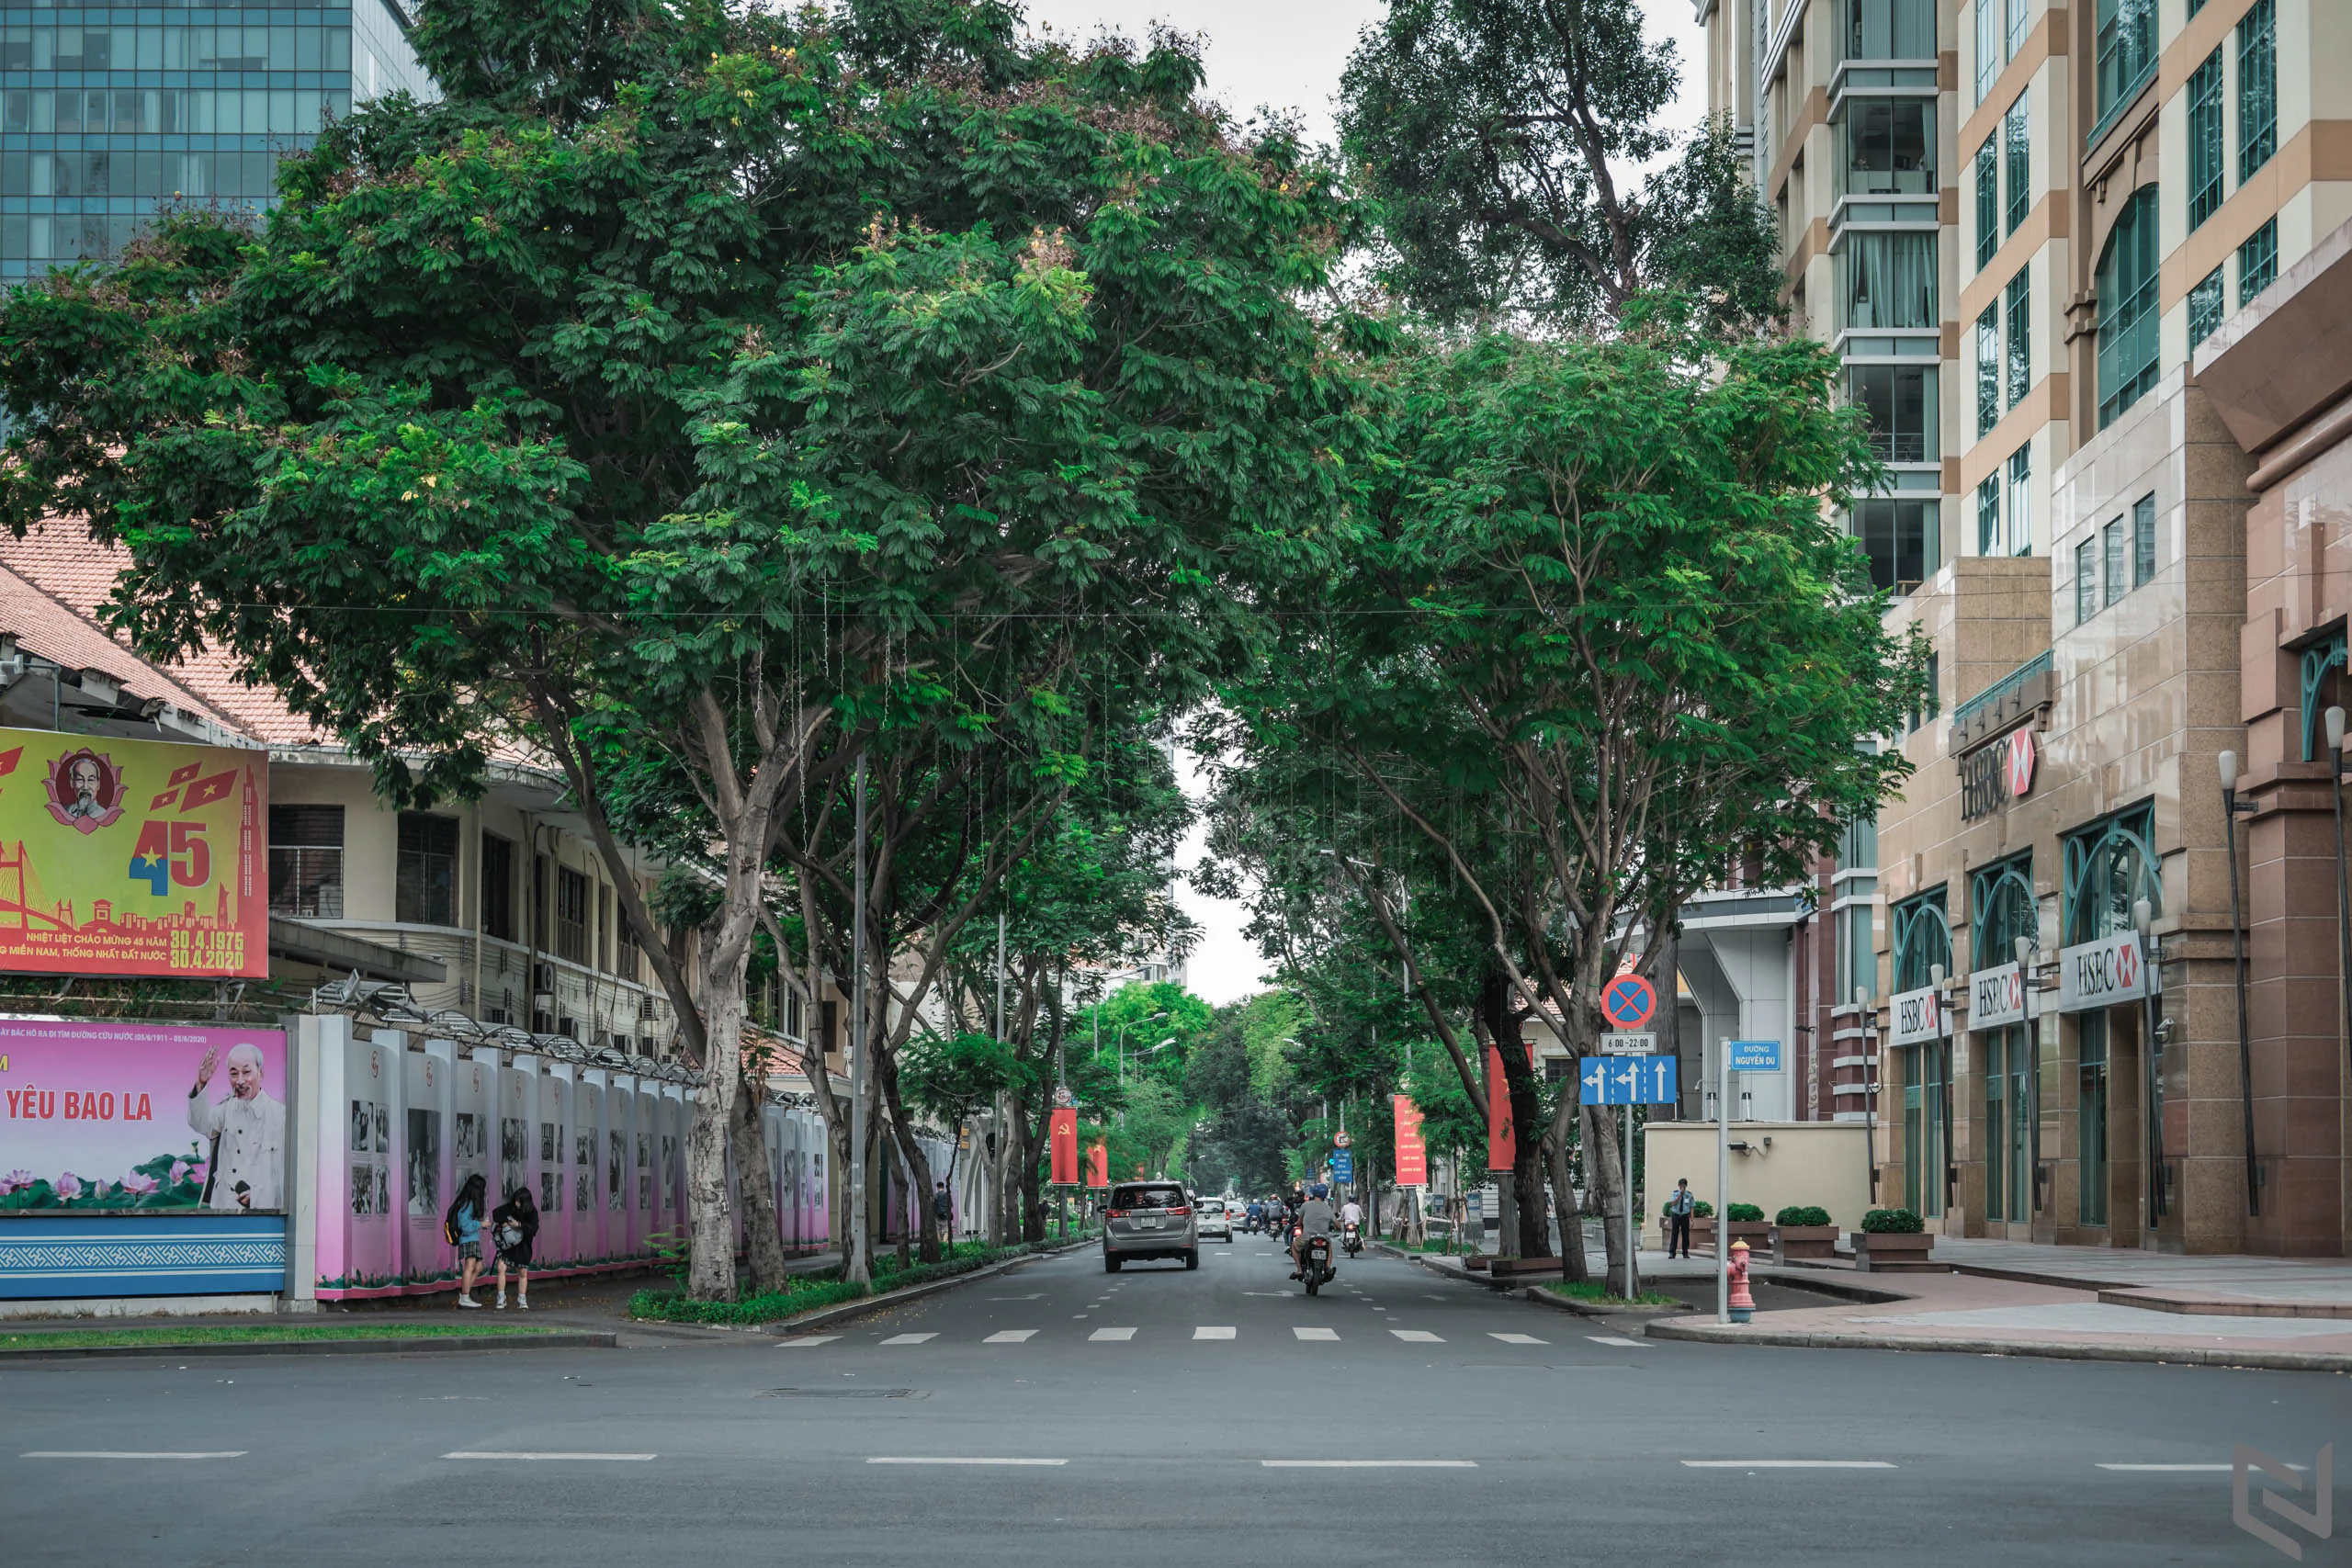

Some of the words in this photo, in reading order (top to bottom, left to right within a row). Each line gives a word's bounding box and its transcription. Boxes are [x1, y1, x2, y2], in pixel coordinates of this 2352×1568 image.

[1961, 738, 2007, 821] HSBC
[129, 820, 211, 897] 45
[26, 931, 52, 944] NHIỆT
[54, 932, 73, 945] LIỆT
[74, 933, 101, 944] CHÀO
[133, 936, 144, 946] 45
[145, 936, 167, 947] NĂM
[170, 930, 244, 951] 30.4.1975
[36, 947, 61, 958] NAM,
[62, 946, 94, 958] THỐNG
[96, 947, 119, 959] NHẤT
[121, 948, 139, 960] ĐẤT
[140, 950, 167, 961] NƯỚC
[169, 949, 244, 970] 30.4.2020
[2076, 947, 2115, 997] HSBC
[1978, 975, 2007, 1018] HSBC
[1900, 995, 1925, 1034] HSBC
[38, 1029, 48, 1037] RA
[1743, 1044, 1770, 1053] ĐƯỜNG
[1766, 1056, 1776, 1066] DU
[6, 1083, 55, 1120] YÊU
[63, 1089, 116, 1121] BAO
[123, 1092, 153, 1122] LA
